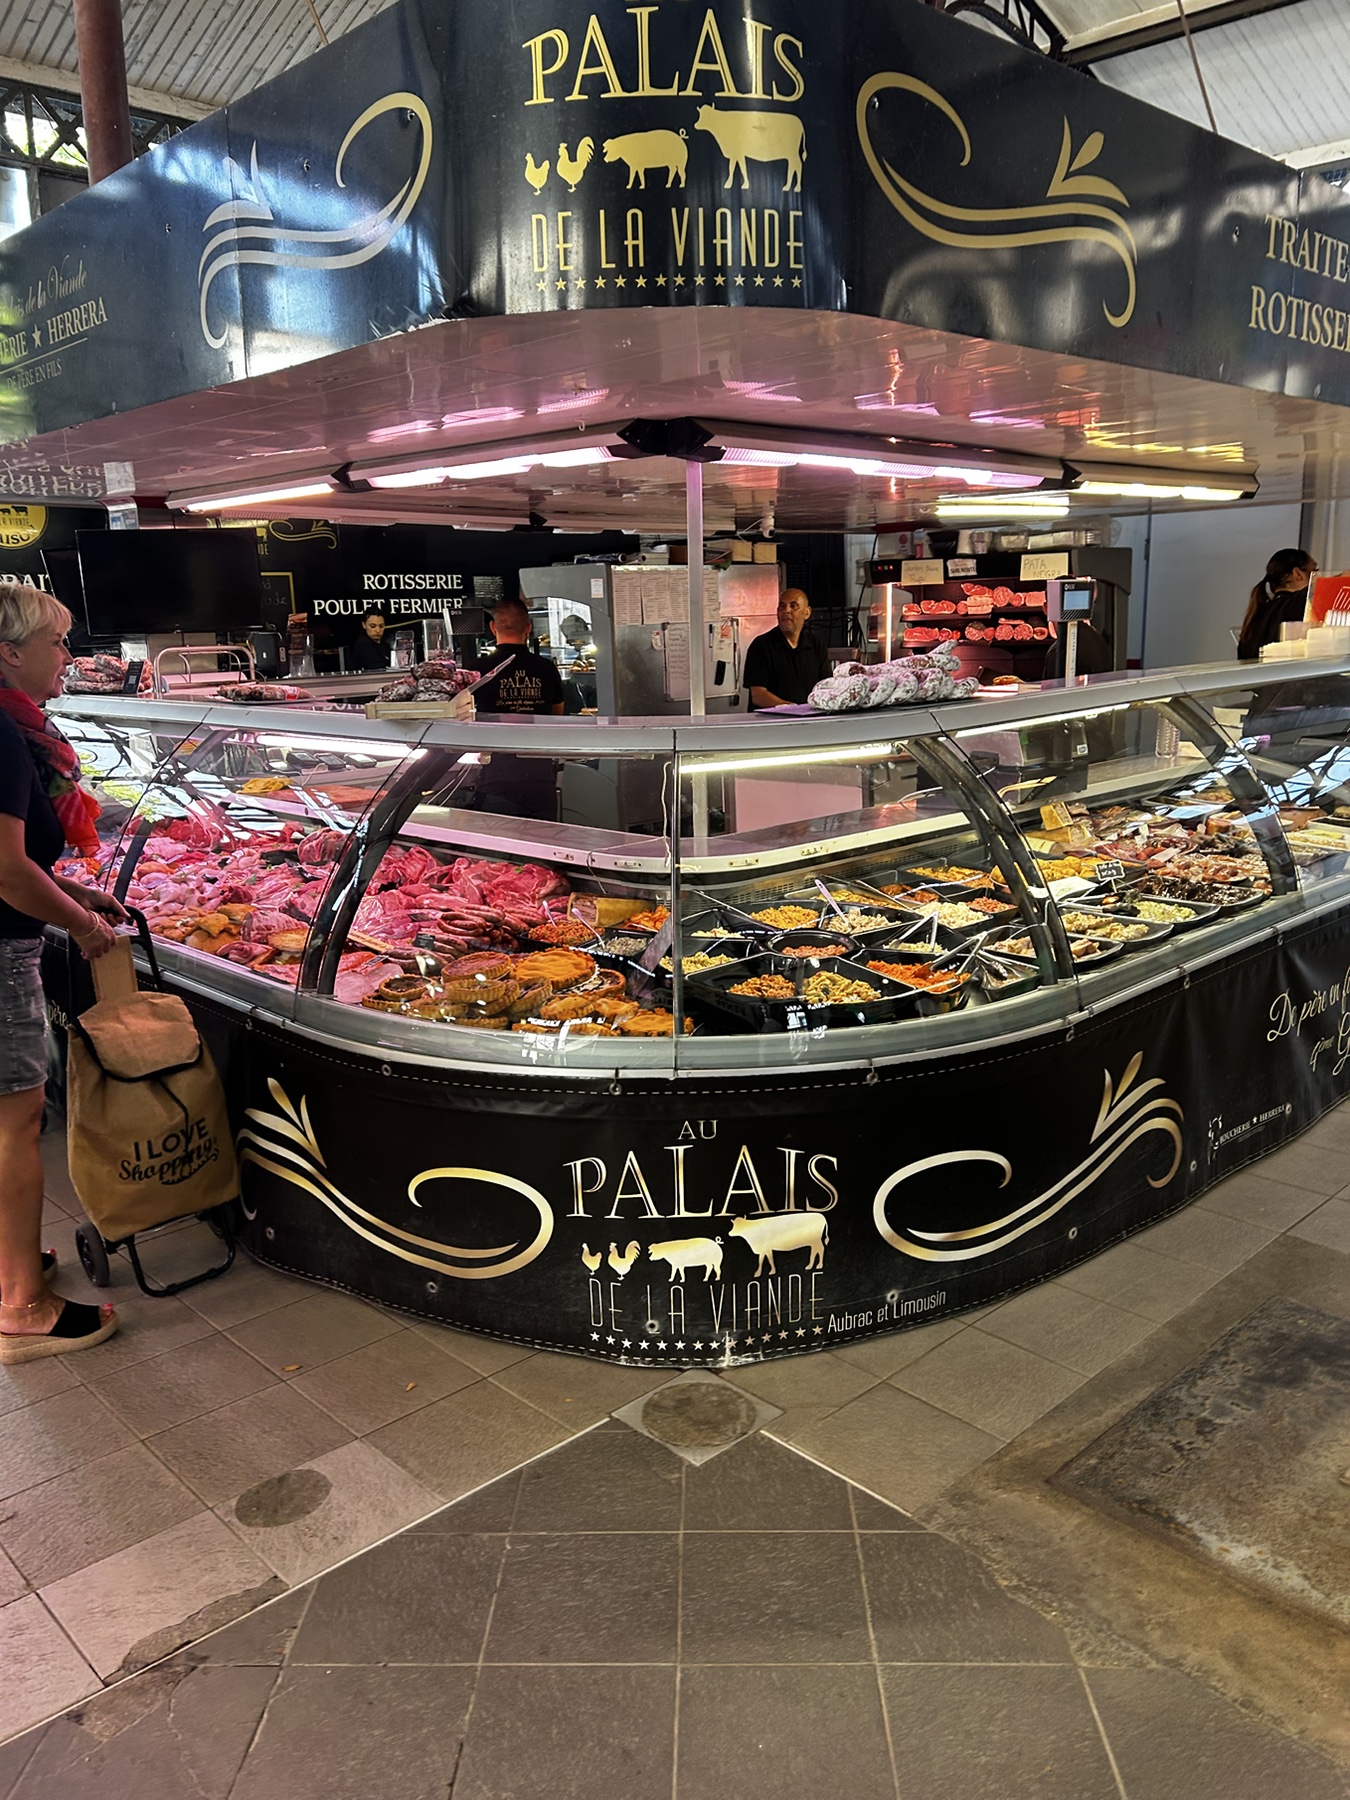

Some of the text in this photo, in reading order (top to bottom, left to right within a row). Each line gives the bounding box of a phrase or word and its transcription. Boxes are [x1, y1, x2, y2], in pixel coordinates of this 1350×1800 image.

[522, 6, 805, 105] PALAIS
[531, 207, 803, 272] DE LA VIANDE
[46, 296, 108, 345] HERRERA
[1248, 285, 1350, 351] ROTISSE
[46, 357, 62, 381] FILS
[363, 574, 463, 590] ROTISSERIE
[1023, 558, 1047, 571] PATA
[313, 598, 463, 616] POULET FERMIER
[501, 677, 543, 689] PALAIS
[1267, 988, 1298, 1041] De
[133, 1117, 209, 1162] I LOVE
[677, 1119, 718, 1140] AU
[562, 1144, 839, 1219] PALAIS
[588, 1271, 825, 1335] DE LA VIANDE
[827, 1290, 946, 1334] Aubrac et Limousin
